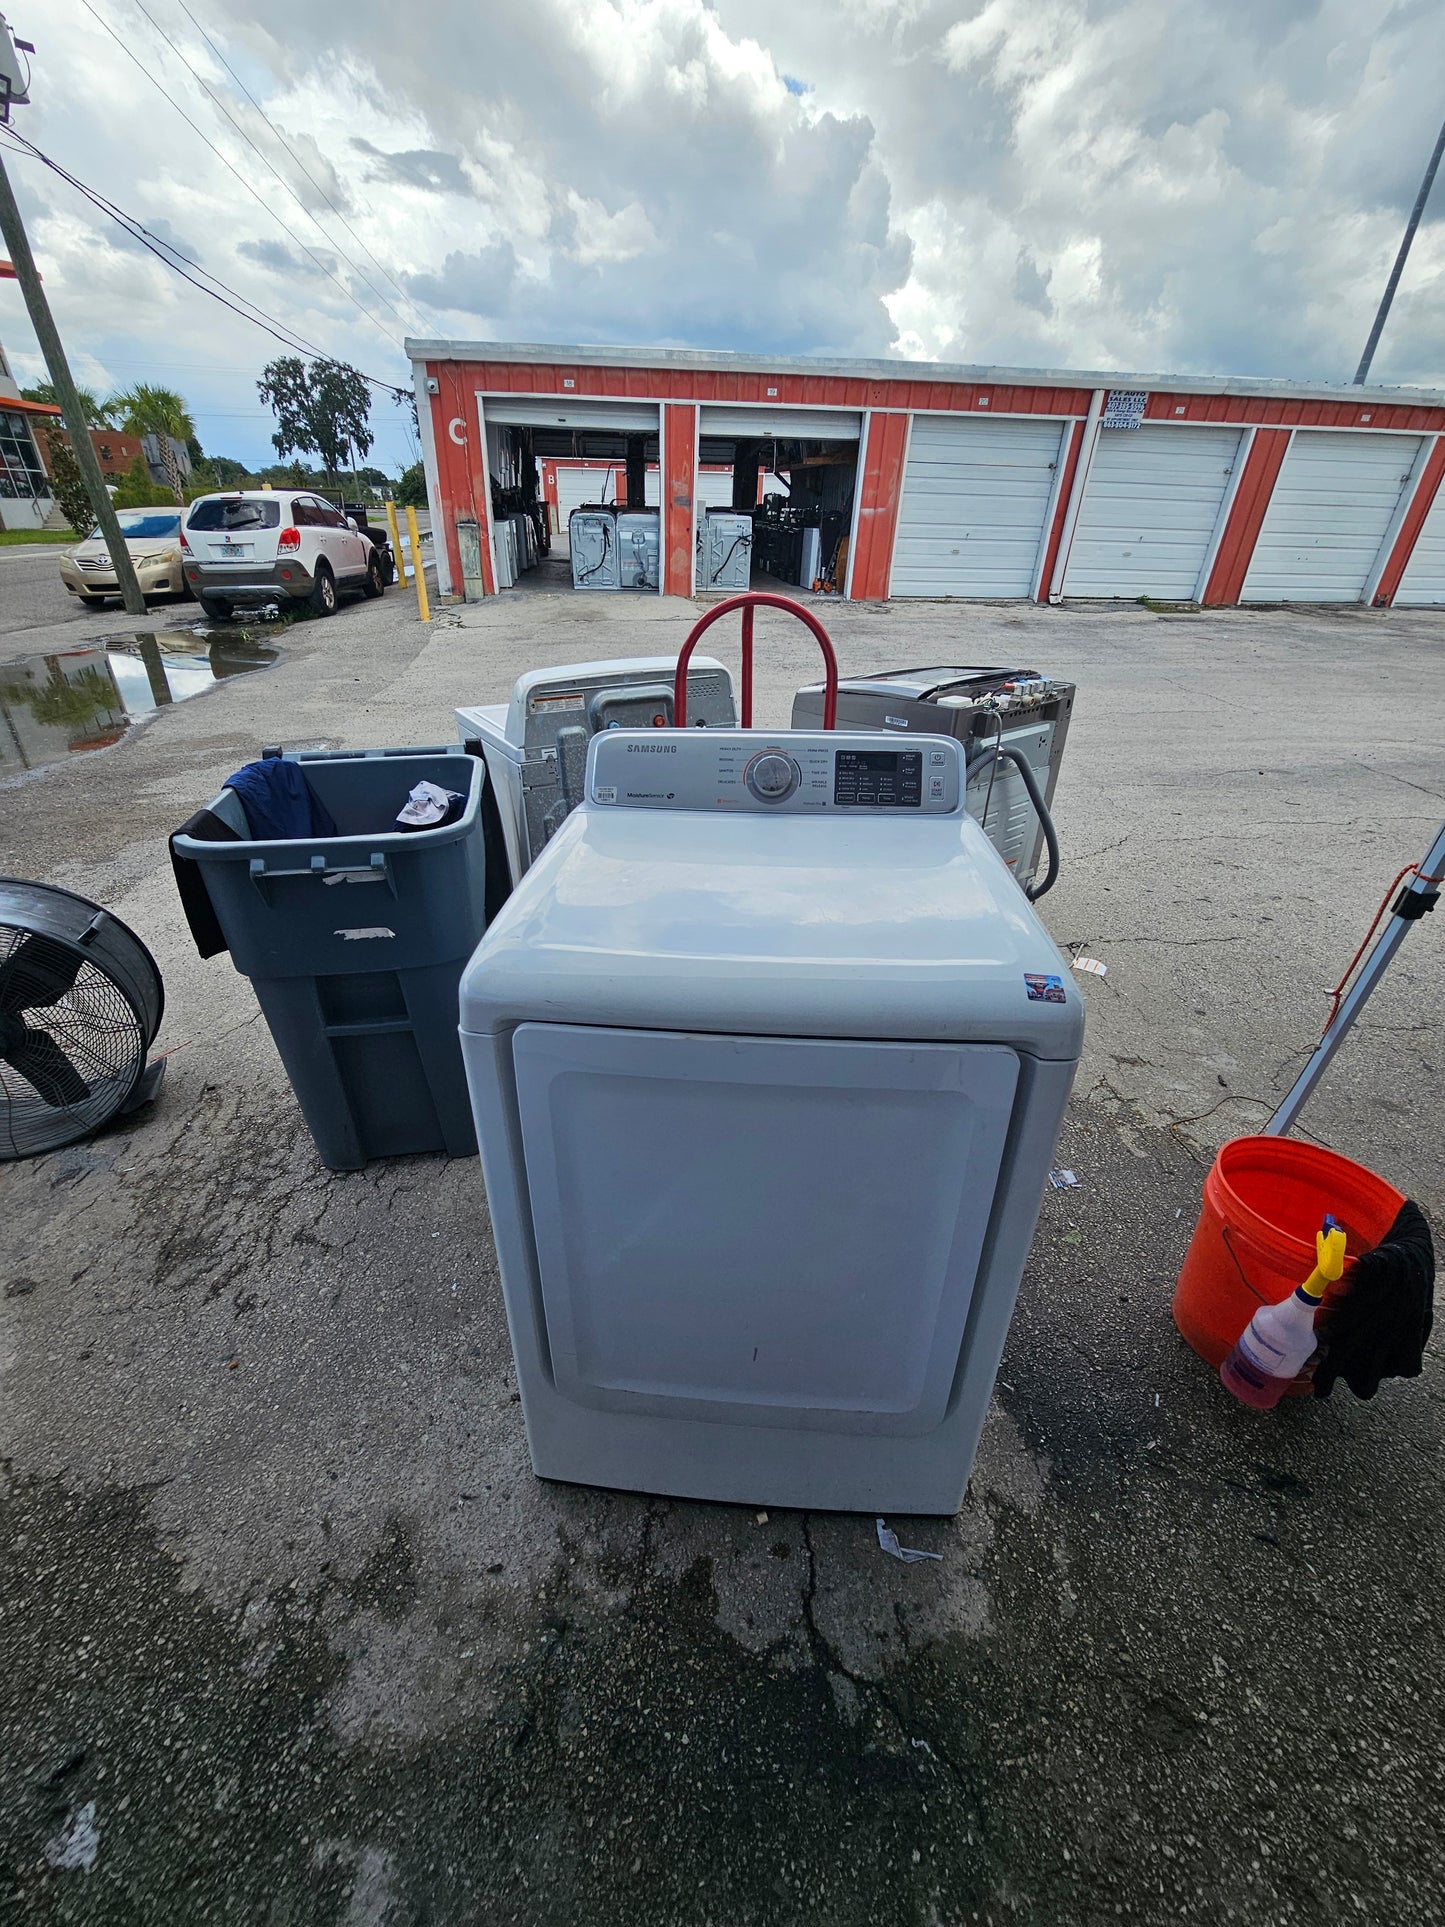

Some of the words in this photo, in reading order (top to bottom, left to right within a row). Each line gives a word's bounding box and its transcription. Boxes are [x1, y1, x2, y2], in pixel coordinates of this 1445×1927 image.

[448, 418, 468, 445] C
[548, 475, 554, 484] B
[627, 744, 677, 754] SAMSUNG
